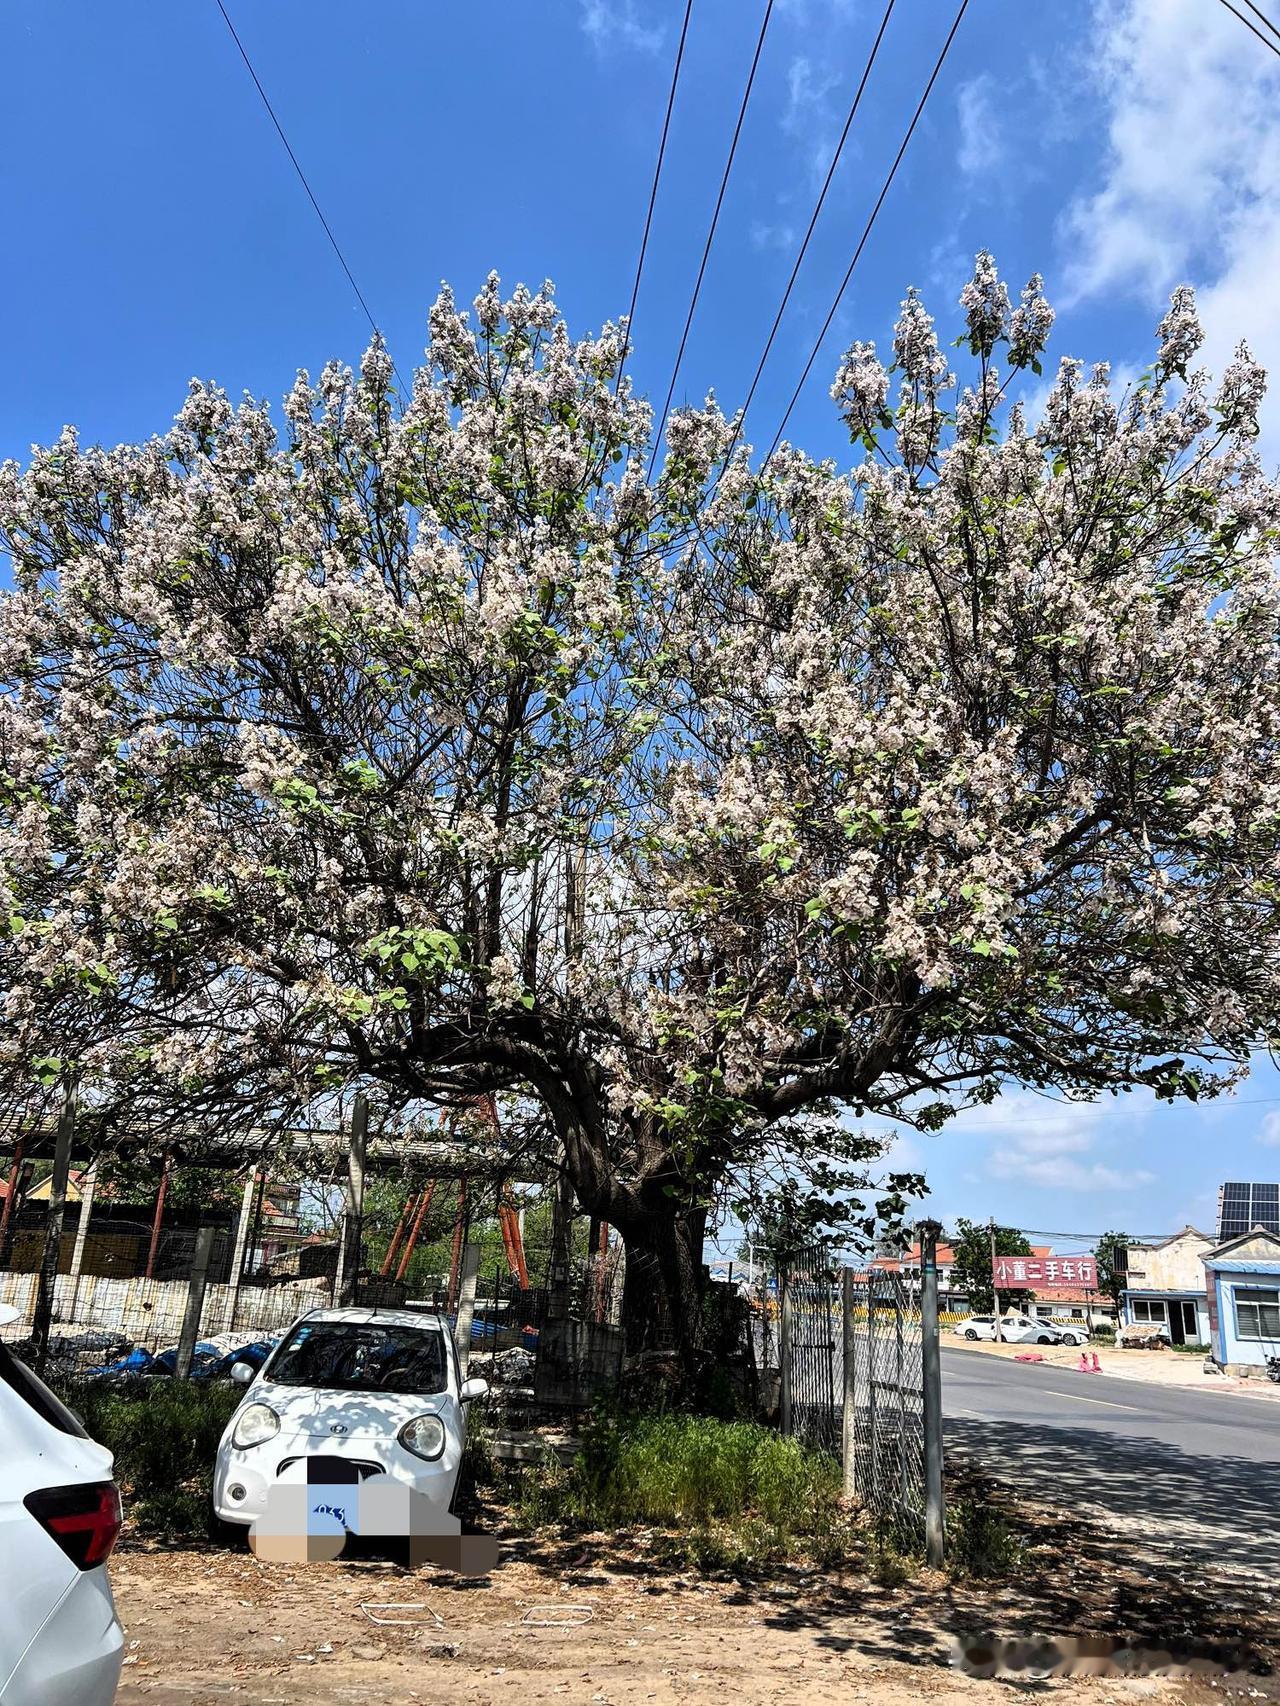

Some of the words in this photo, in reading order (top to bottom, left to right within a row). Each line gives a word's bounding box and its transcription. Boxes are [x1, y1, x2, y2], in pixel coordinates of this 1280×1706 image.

[997, 1260, 1092, 1281] 小董二手车行
